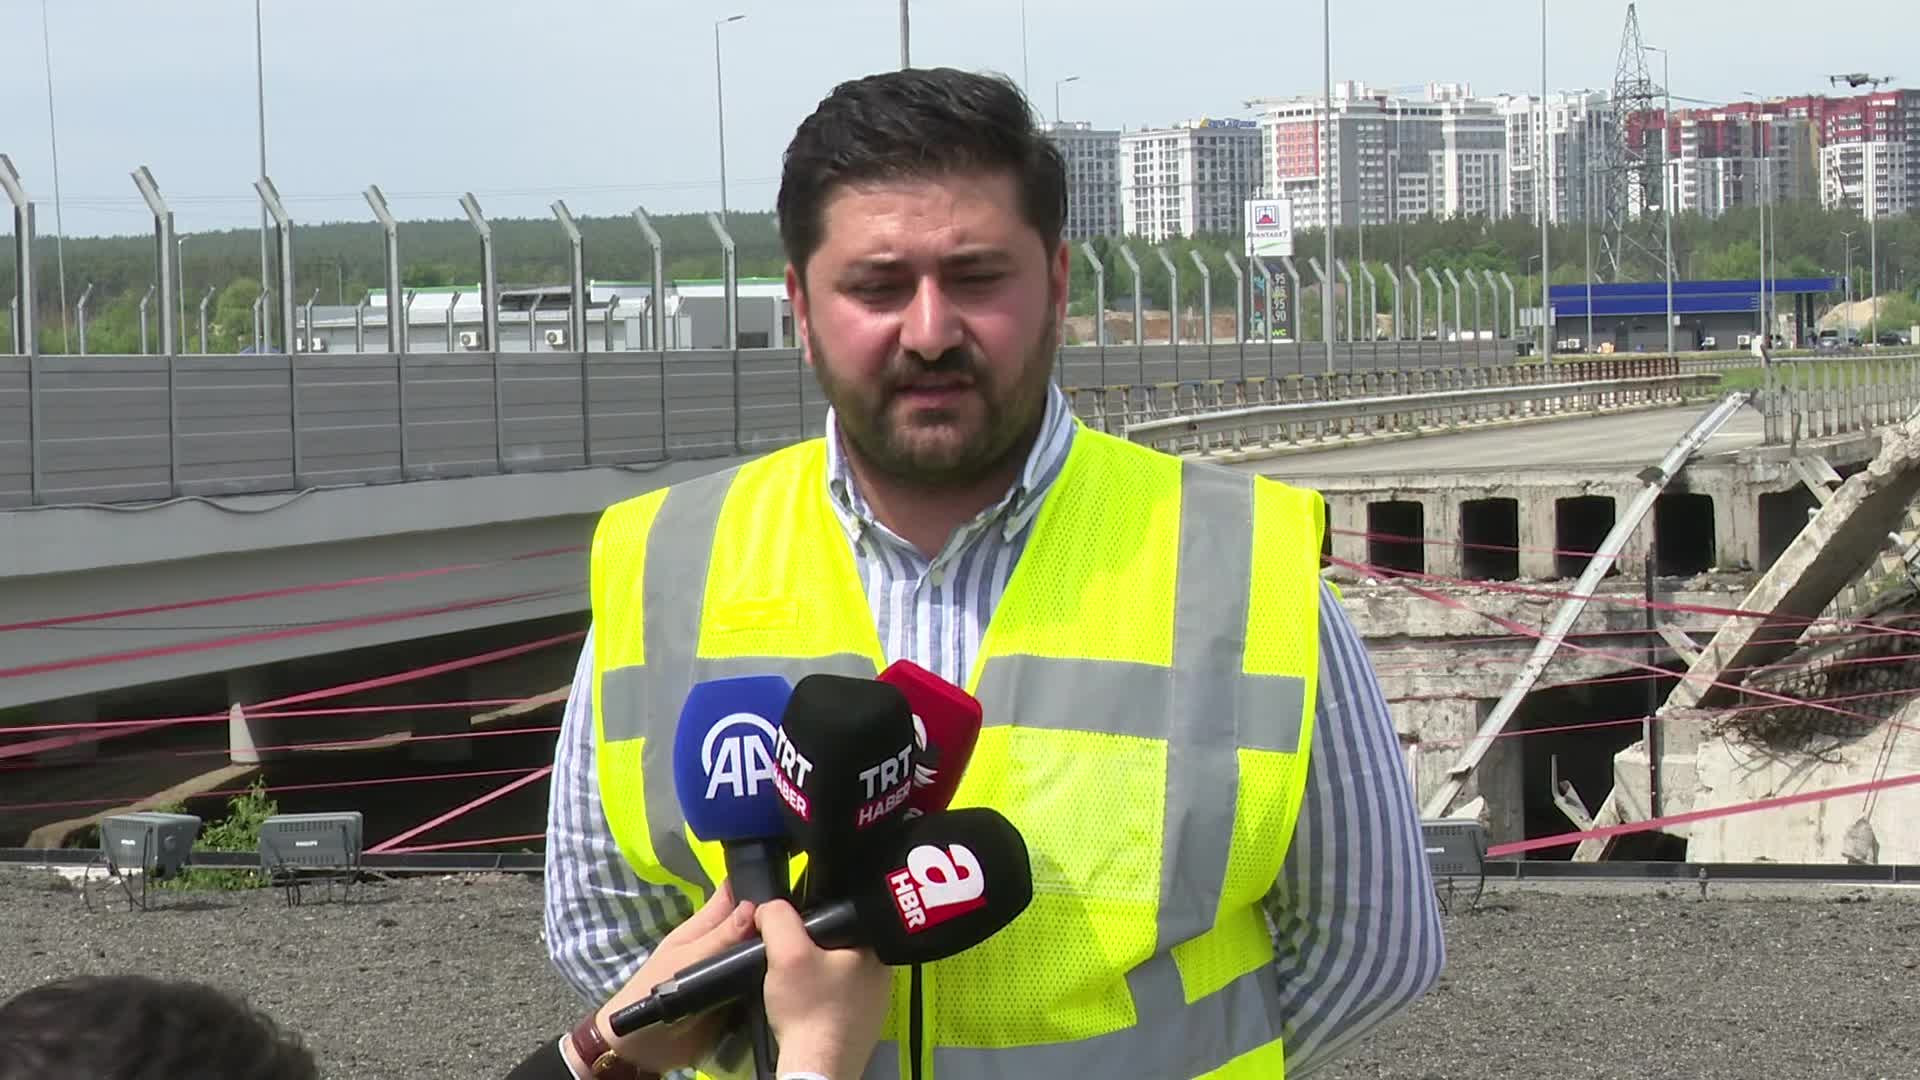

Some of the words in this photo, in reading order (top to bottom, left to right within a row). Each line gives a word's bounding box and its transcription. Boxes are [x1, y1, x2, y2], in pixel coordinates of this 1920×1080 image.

[705, 735, 775, 799] AA
[776, 724, 813, 788] TRT
[859, 744, 912, 799] TRT
[857, 781, 911, 826] HABER
[890, 871, 926, 928] HBR
